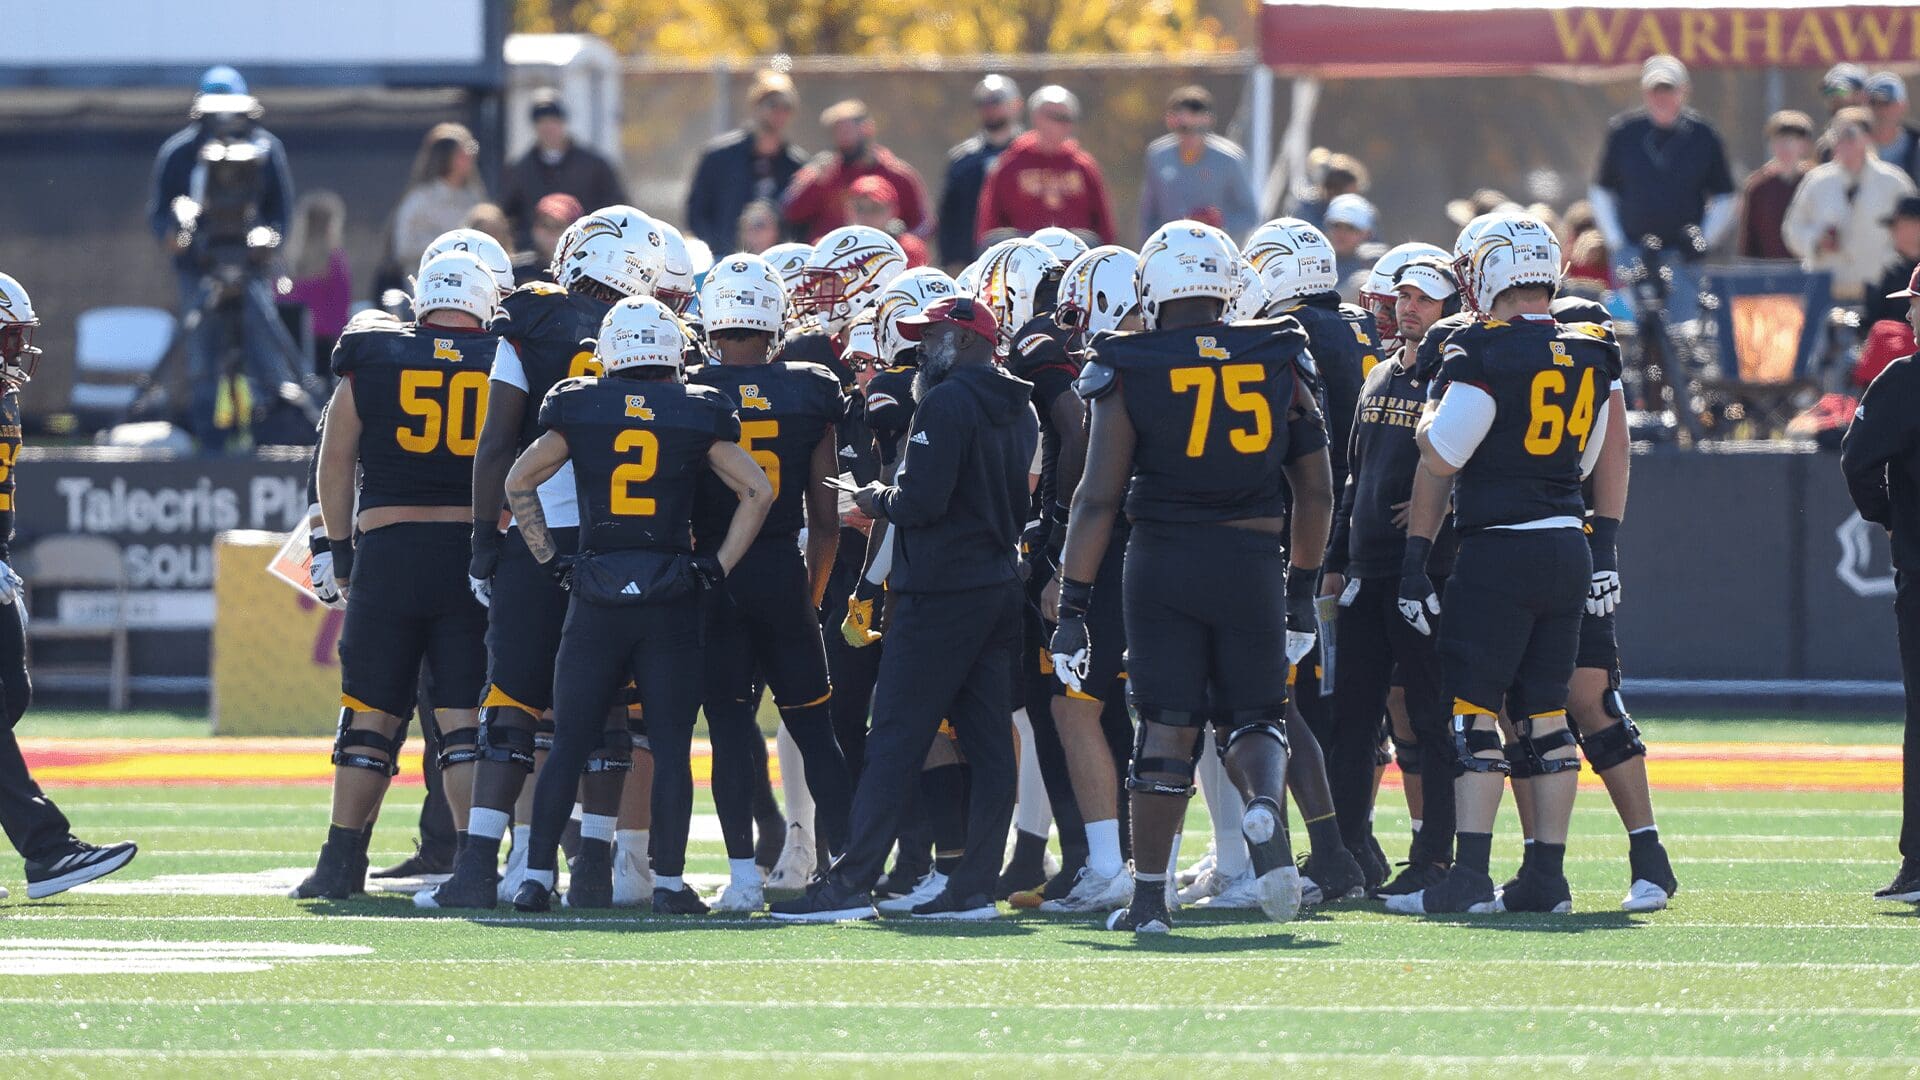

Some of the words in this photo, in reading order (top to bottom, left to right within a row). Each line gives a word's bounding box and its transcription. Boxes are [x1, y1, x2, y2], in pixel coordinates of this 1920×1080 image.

[1553, 9, 1920, 62] WARHAW
[604, 275, 641, 295] WARHA
[711, 318, 767, 327] WARHAWKS
[612, 353, 669, 367] WARHAWKS
[396, 369, 490, 456] 50
[1169, 363, 1273, 458] 75
[1524, 366, 1596, 456] 64
[610, 428, 659, 516] 2
[57, 477, 239, 533] Talecris
[250, 476, 308, 531] Pl
[1154, 785, 1186, 794] DONJOY
